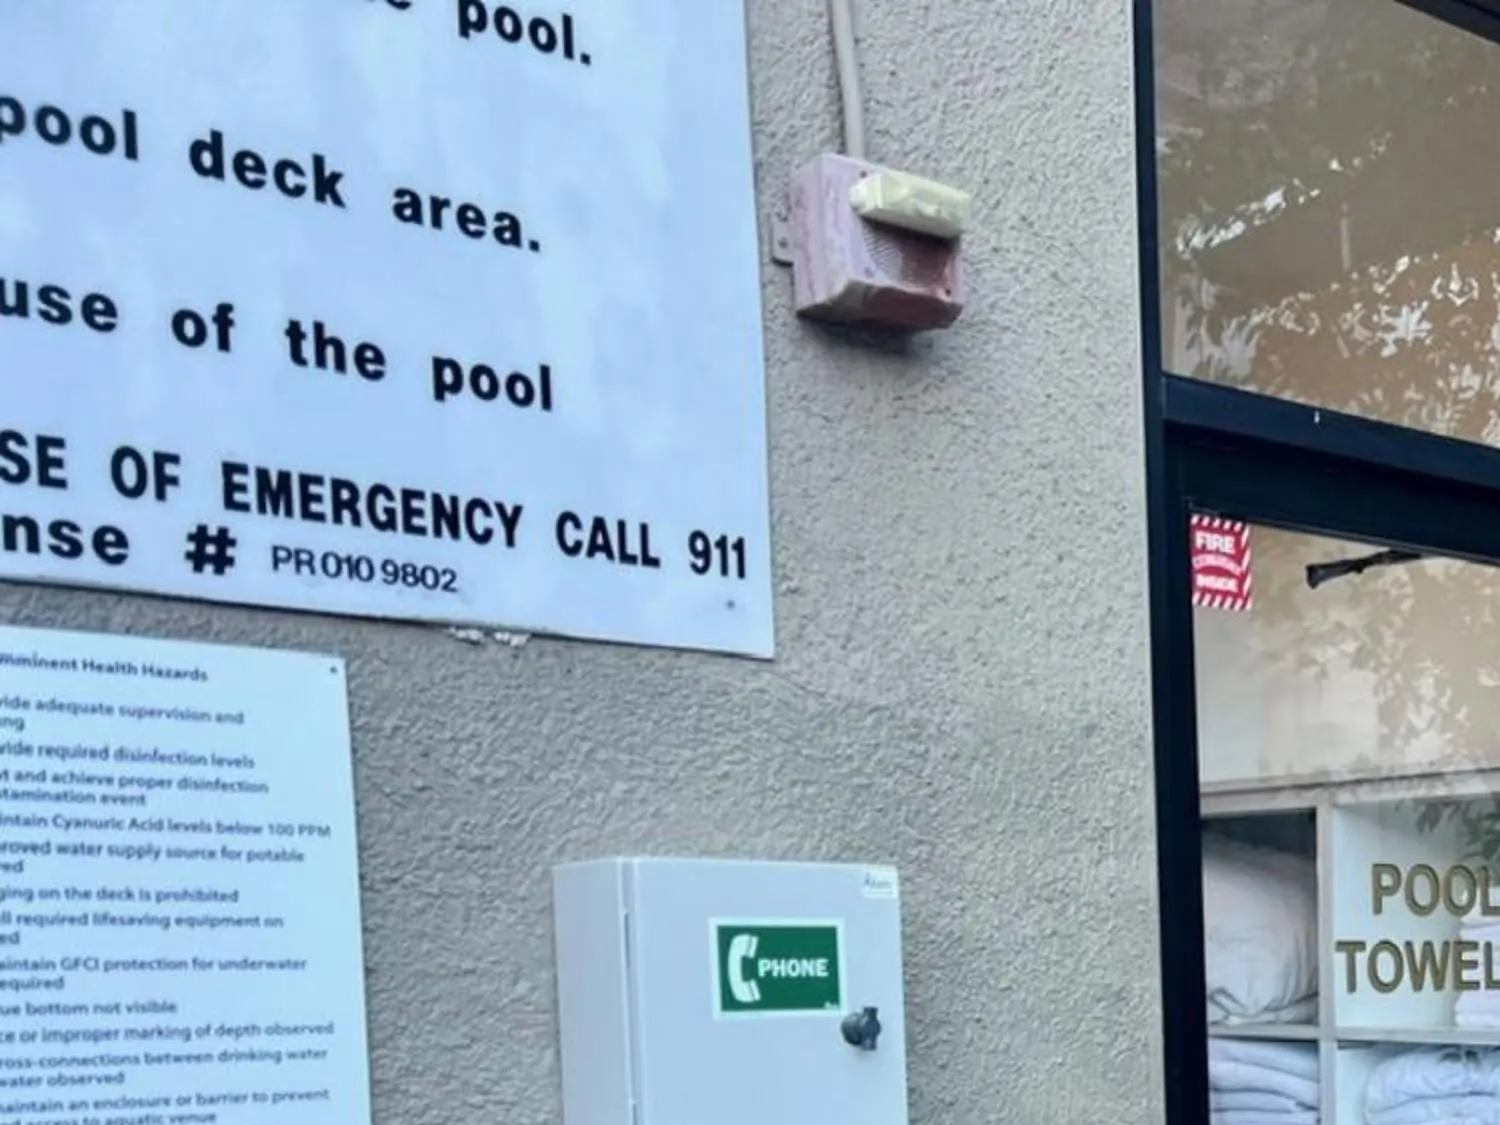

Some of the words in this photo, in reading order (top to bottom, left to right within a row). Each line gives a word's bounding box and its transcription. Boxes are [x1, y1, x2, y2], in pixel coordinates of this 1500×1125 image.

[457, 0, 592, 66] pool.
[0, 96, 140, 162] pool
[188, 129, 347, 208] deck
[392, 186, 541, 252] area.
[0, 277, 118, 333] use
[171, 303, 235, 352] of
[285, 319, 387, 381] the
[432, 355, 553, 411] pool
[0, 429, 68, 489] SE
[110, 445, 181, 502] OF
[221, 460, 523, 549] EMERGENCY
[555, 511, 661, 569] CALL
[688, 531, 747, 579] 911
[2, 513, 130, 566] nse
[184, 523, 237, 576] #
[381, 559, 458, 593] 9802
[1195, 531, 1236, 554] FIRE
[82, 659, 138, 675] Health
[142, 664, 208, 681] Hazards
[0, 695, 30, 710] ide
[36, 698, 113, 716] adequate
[119, 705, 210, 722] supervision
[216, 712, 244, 725] and
[38, 744, 109, 762] required
[114, 746, 207, 766] disinfection
[211, 753, 254, 769] levels
[14, 769, 46, 783] and
[52, 771, 114, 786] achieve
[119, 776, 172, 790] proper
[178, 776, 269, 793] disinfection
[102, 794, 146, 806] event
[52, 814, 124, 832] Cyanuric
[129, 817, 163, 832] Acid
[168, 818, 212, 833] levels
[217, 820, 262, 835] below
[269, 823, 294, 837] 100
[298, 824, 331, 837] PPM
[56, 842, 102, 856] water
[107, 843, 160, 861] supply
[166, 847, 216, 860] source
[221, 845, 242, 861] for
[246, 848, 304, 863] potable
[38, 888, 60, 900] on
[65, 886, 91, 900] the
[96, 887, 135, 901] deck
[139, 888, 151, 901] is
[156, 889, 239, 904] prohibited
[16, 912, 88, 928] required
[93, 912, 170, 930] lifesaving
[175, 915, 260, 929] equipment
[264, 917, 283, 928] on
[60, 957, 99, 972] GFCI
[103, 958, 188, 973] protection
[192, 957, 213, 971] for
[218, 957, 306, 971] underwater
[758, 957, 829, 978] PHONE
[26, 1002, 89, 1016] bottom
[94, 1002, 121, 1015] not
[126, 1000, 177, 1014] visible
[19, 1030, 38, 1044] or
[42, 1027, 120, 1045] improper
[125, 1025, 191, 1042] marking
[195, 1024, 213, 1038] of
[215, 1024, 261, 1040] depth
[264, 1021, 334, 1036] observed
[144, 1052, 213, 1065] between
[218, 1048, 282, 1064] drinking
[287, 1049, 327, 1060] water
[47, 1071, 125, 1087] observed
[69, 1100, 89, 1111] an
[93, 1095, 171, 1110] enclosure
[176, 1095, 193, 1107] or
[197, 1093, 248, 1106] barrier
[252, 1092, 269, 1103] to
[272, 1089, 330, 1105] prevent
[169, 1113, 216, 1125] venue
